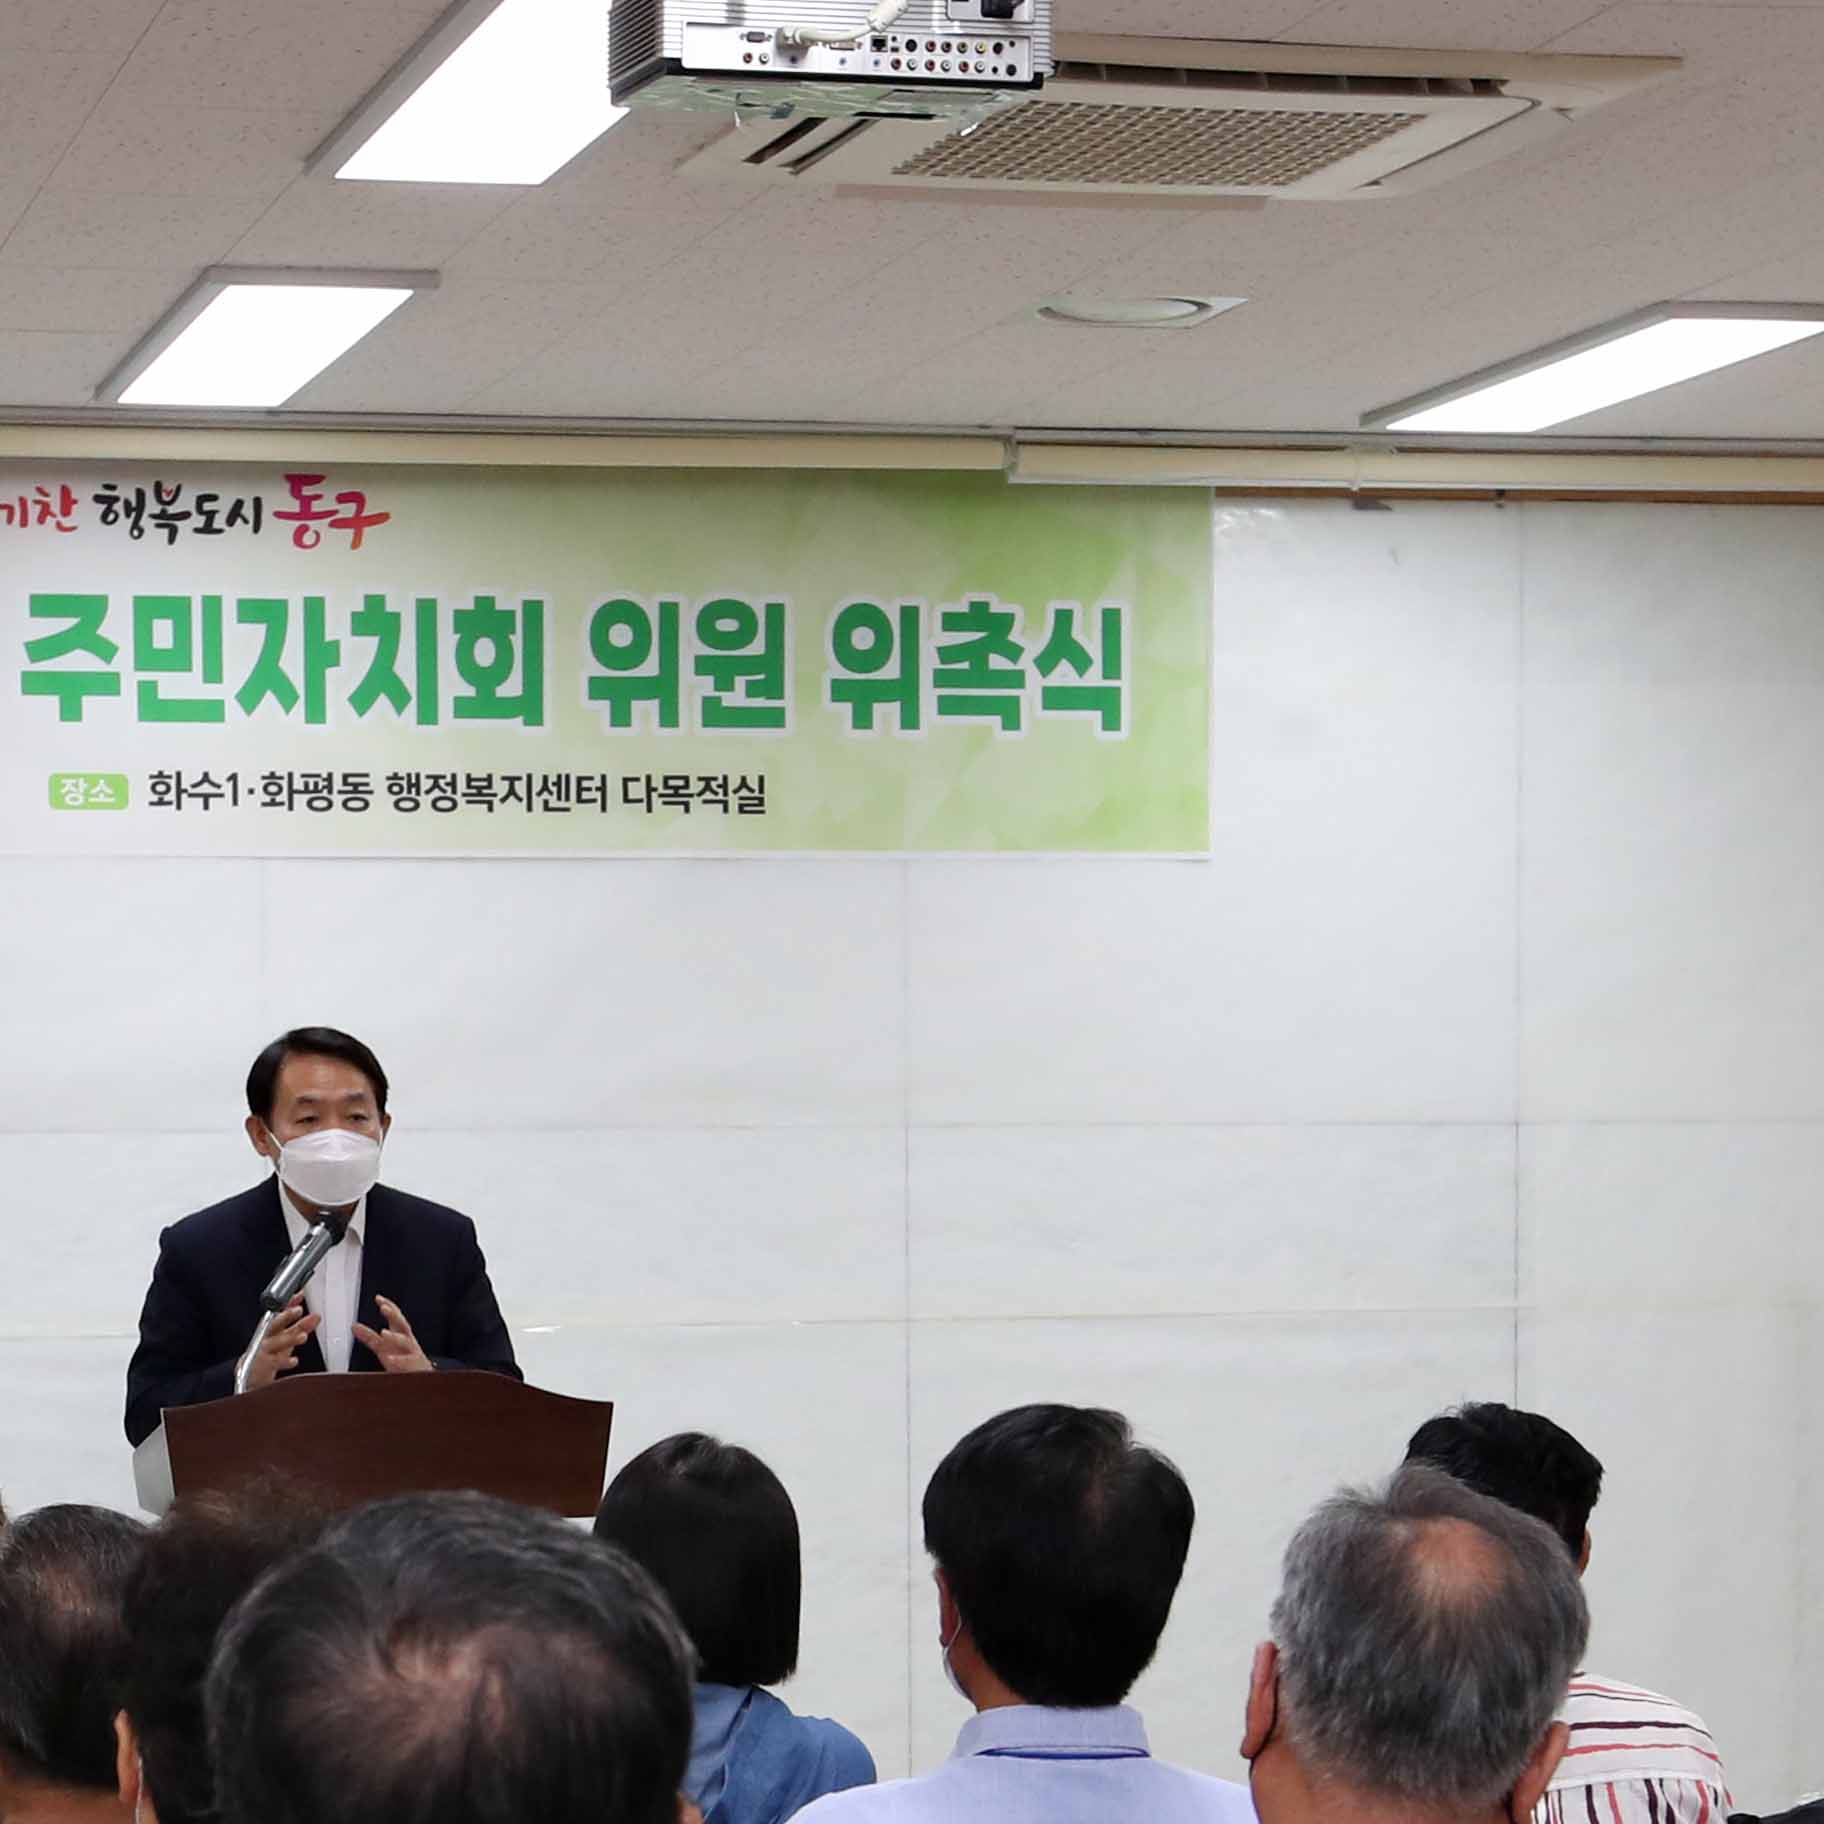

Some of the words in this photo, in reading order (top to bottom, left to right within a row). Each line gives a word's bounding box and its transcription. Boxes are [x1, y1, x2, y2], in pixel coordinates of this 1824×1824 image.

[92, 481, 265, 543] 행복도시
[272, 474, 391, 551] 동구
[21, 593, 545, 727] 주민자치회
[588, 598, 788, 730] 위원
[830, 598, 1124, 732] 위촉식
[60, 776, 116, 806] 장소
[148, 769, 375, 813] 화수1·화평동
[385, 771, 609, 814] 행정복지센터
[622, 772, 767, 814] 다목적실
